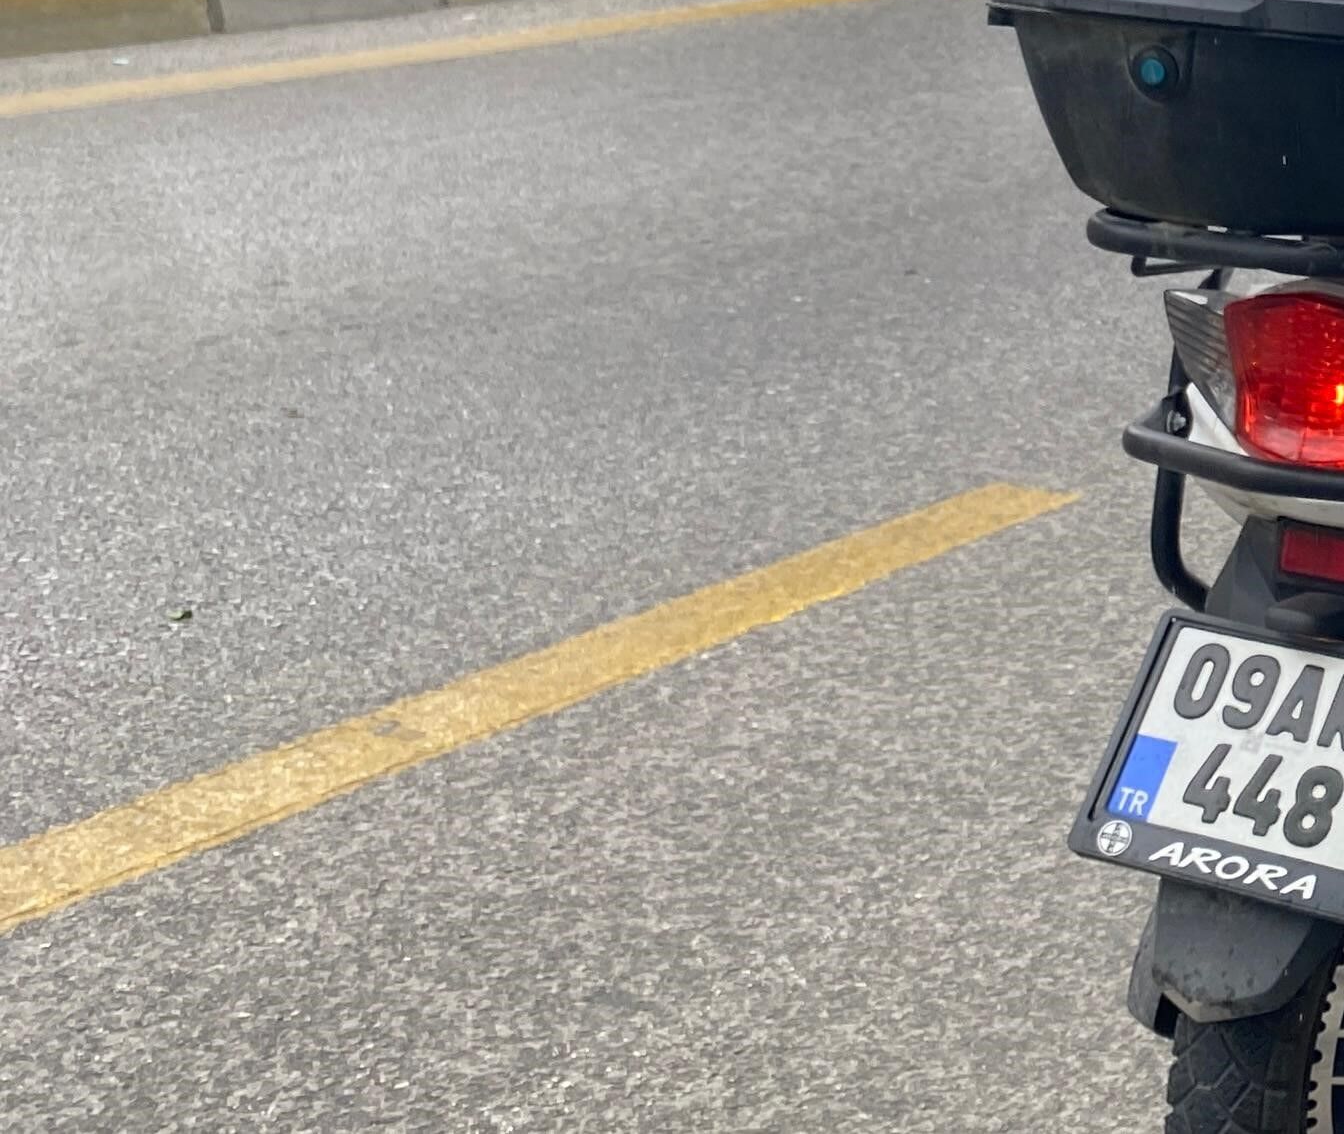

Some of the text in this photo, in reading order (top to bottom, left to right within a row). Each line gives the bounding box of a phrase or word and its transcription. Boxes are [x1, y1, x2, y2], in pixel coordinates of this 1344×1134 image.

[1118, 787, 1148, 816] TR
[1182, 743, 1344, 848] 448
[1149, 841, 1318, 900] ARORA
